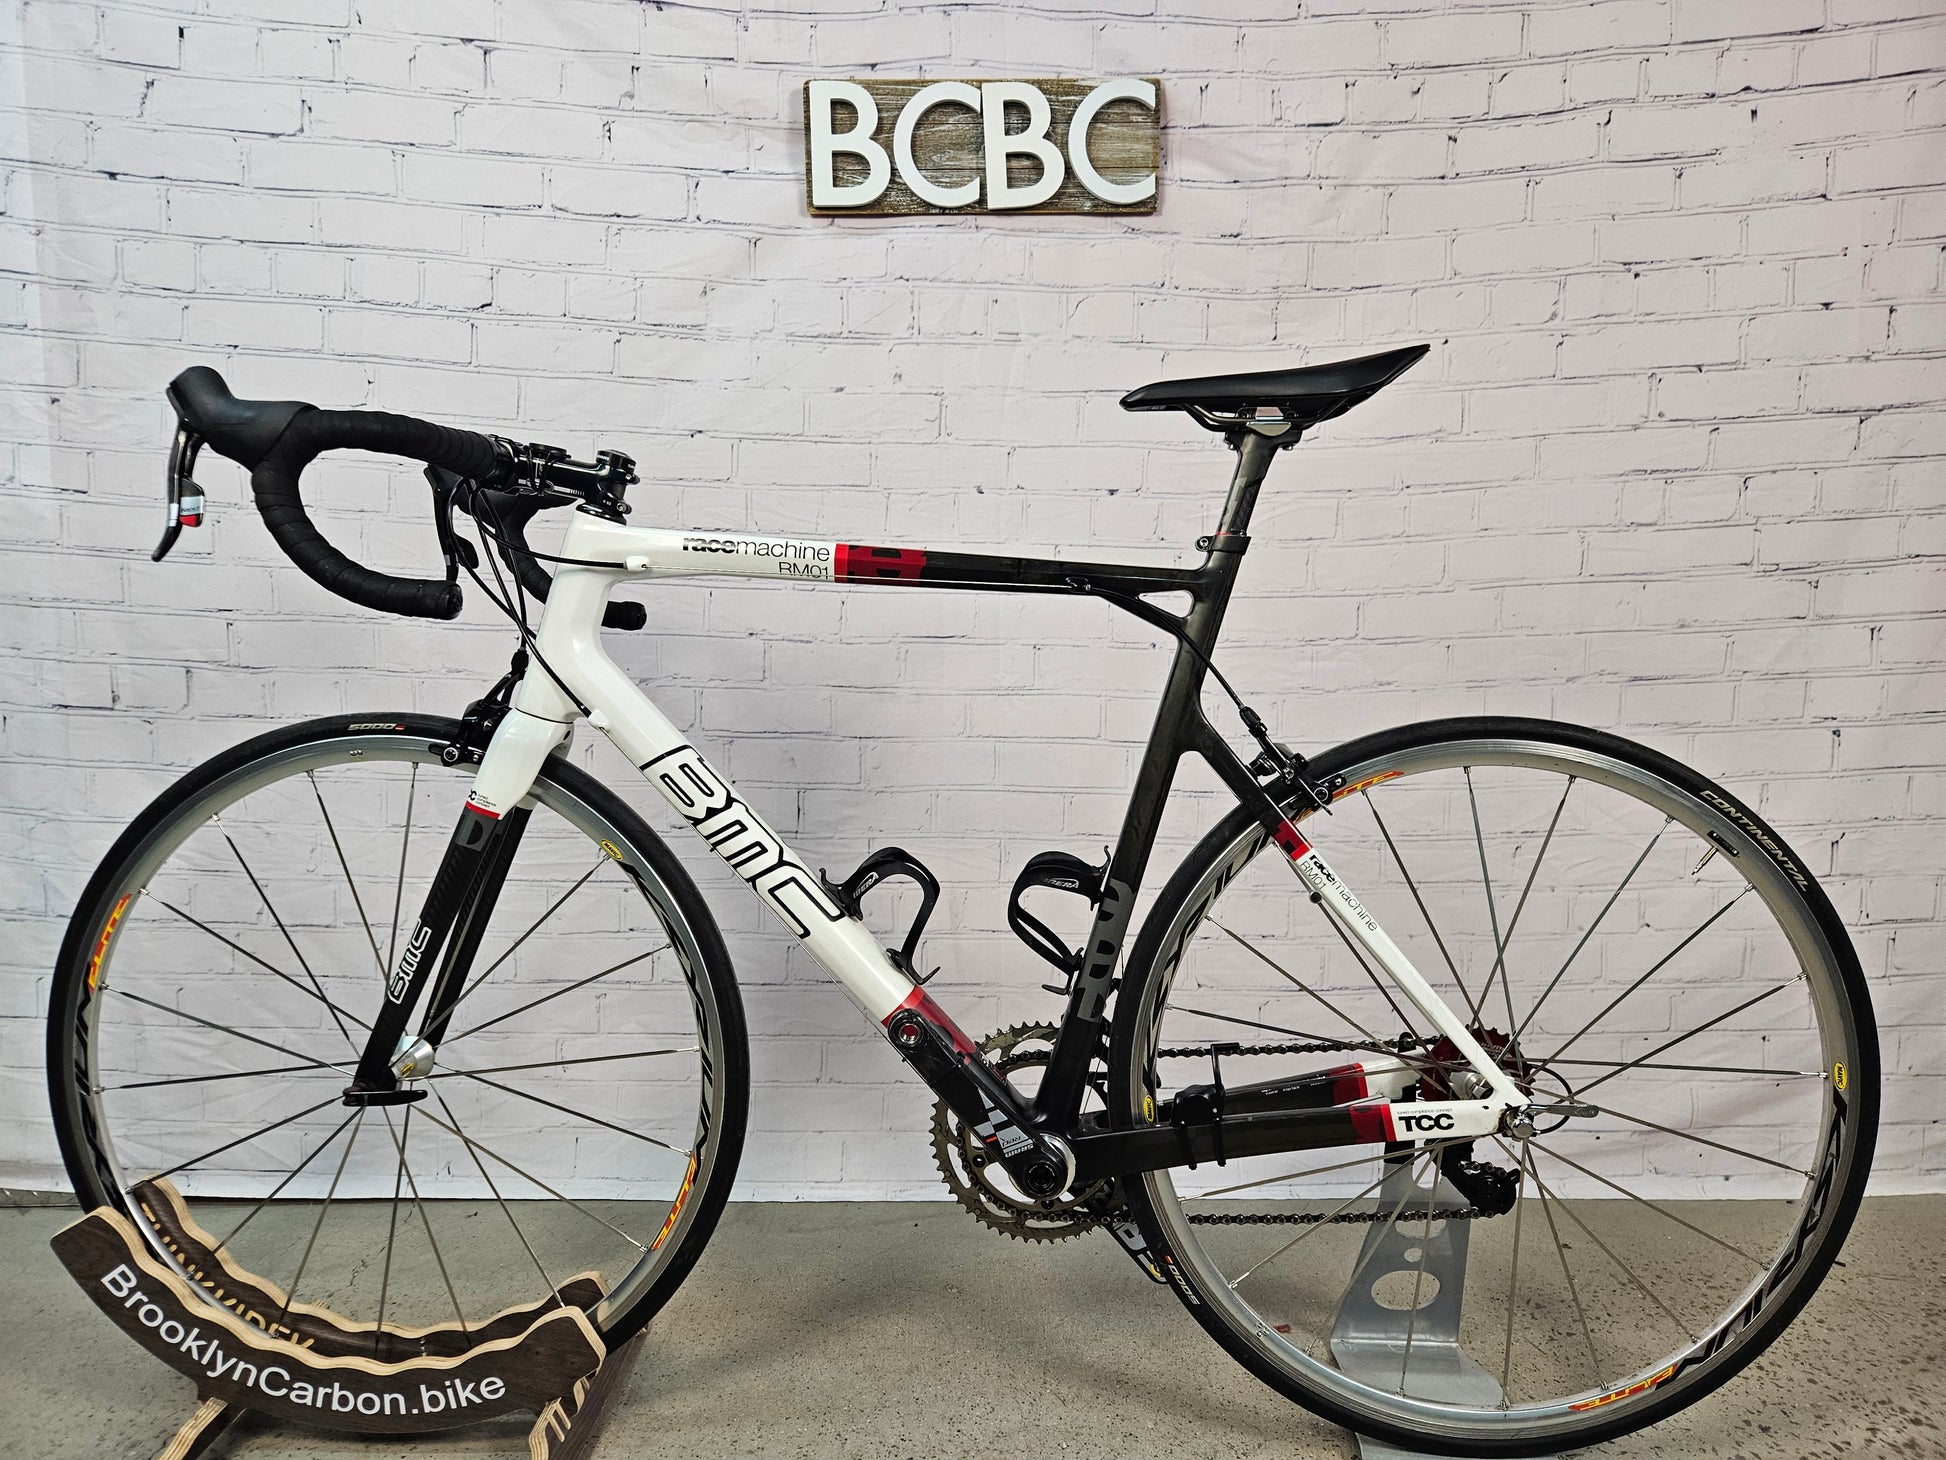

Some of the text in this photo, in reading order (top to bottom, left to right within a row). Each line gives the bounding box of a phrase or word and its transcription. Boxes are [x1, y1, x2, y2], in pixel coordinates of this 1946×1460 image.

[809, 79, 1156, 210] BCBC
[683, 537, 830, 562] racemachine
[779, 562, 830, 580] RM01
[603, 841, 619, 858] MAVIC
[638, 745, 846, 940] BMC
[1300, 860, 1327, 889] RM01
[1699, 790, 1808, 892] CONTINENTAL
[1309, 855, 1378, 932] racemachine
[387, 918, 432, 1005] BMC
[1398, 1114, 1454, 1132] TCC
[101, 1264, 506, 1415] BrooklynCarbon.bike
